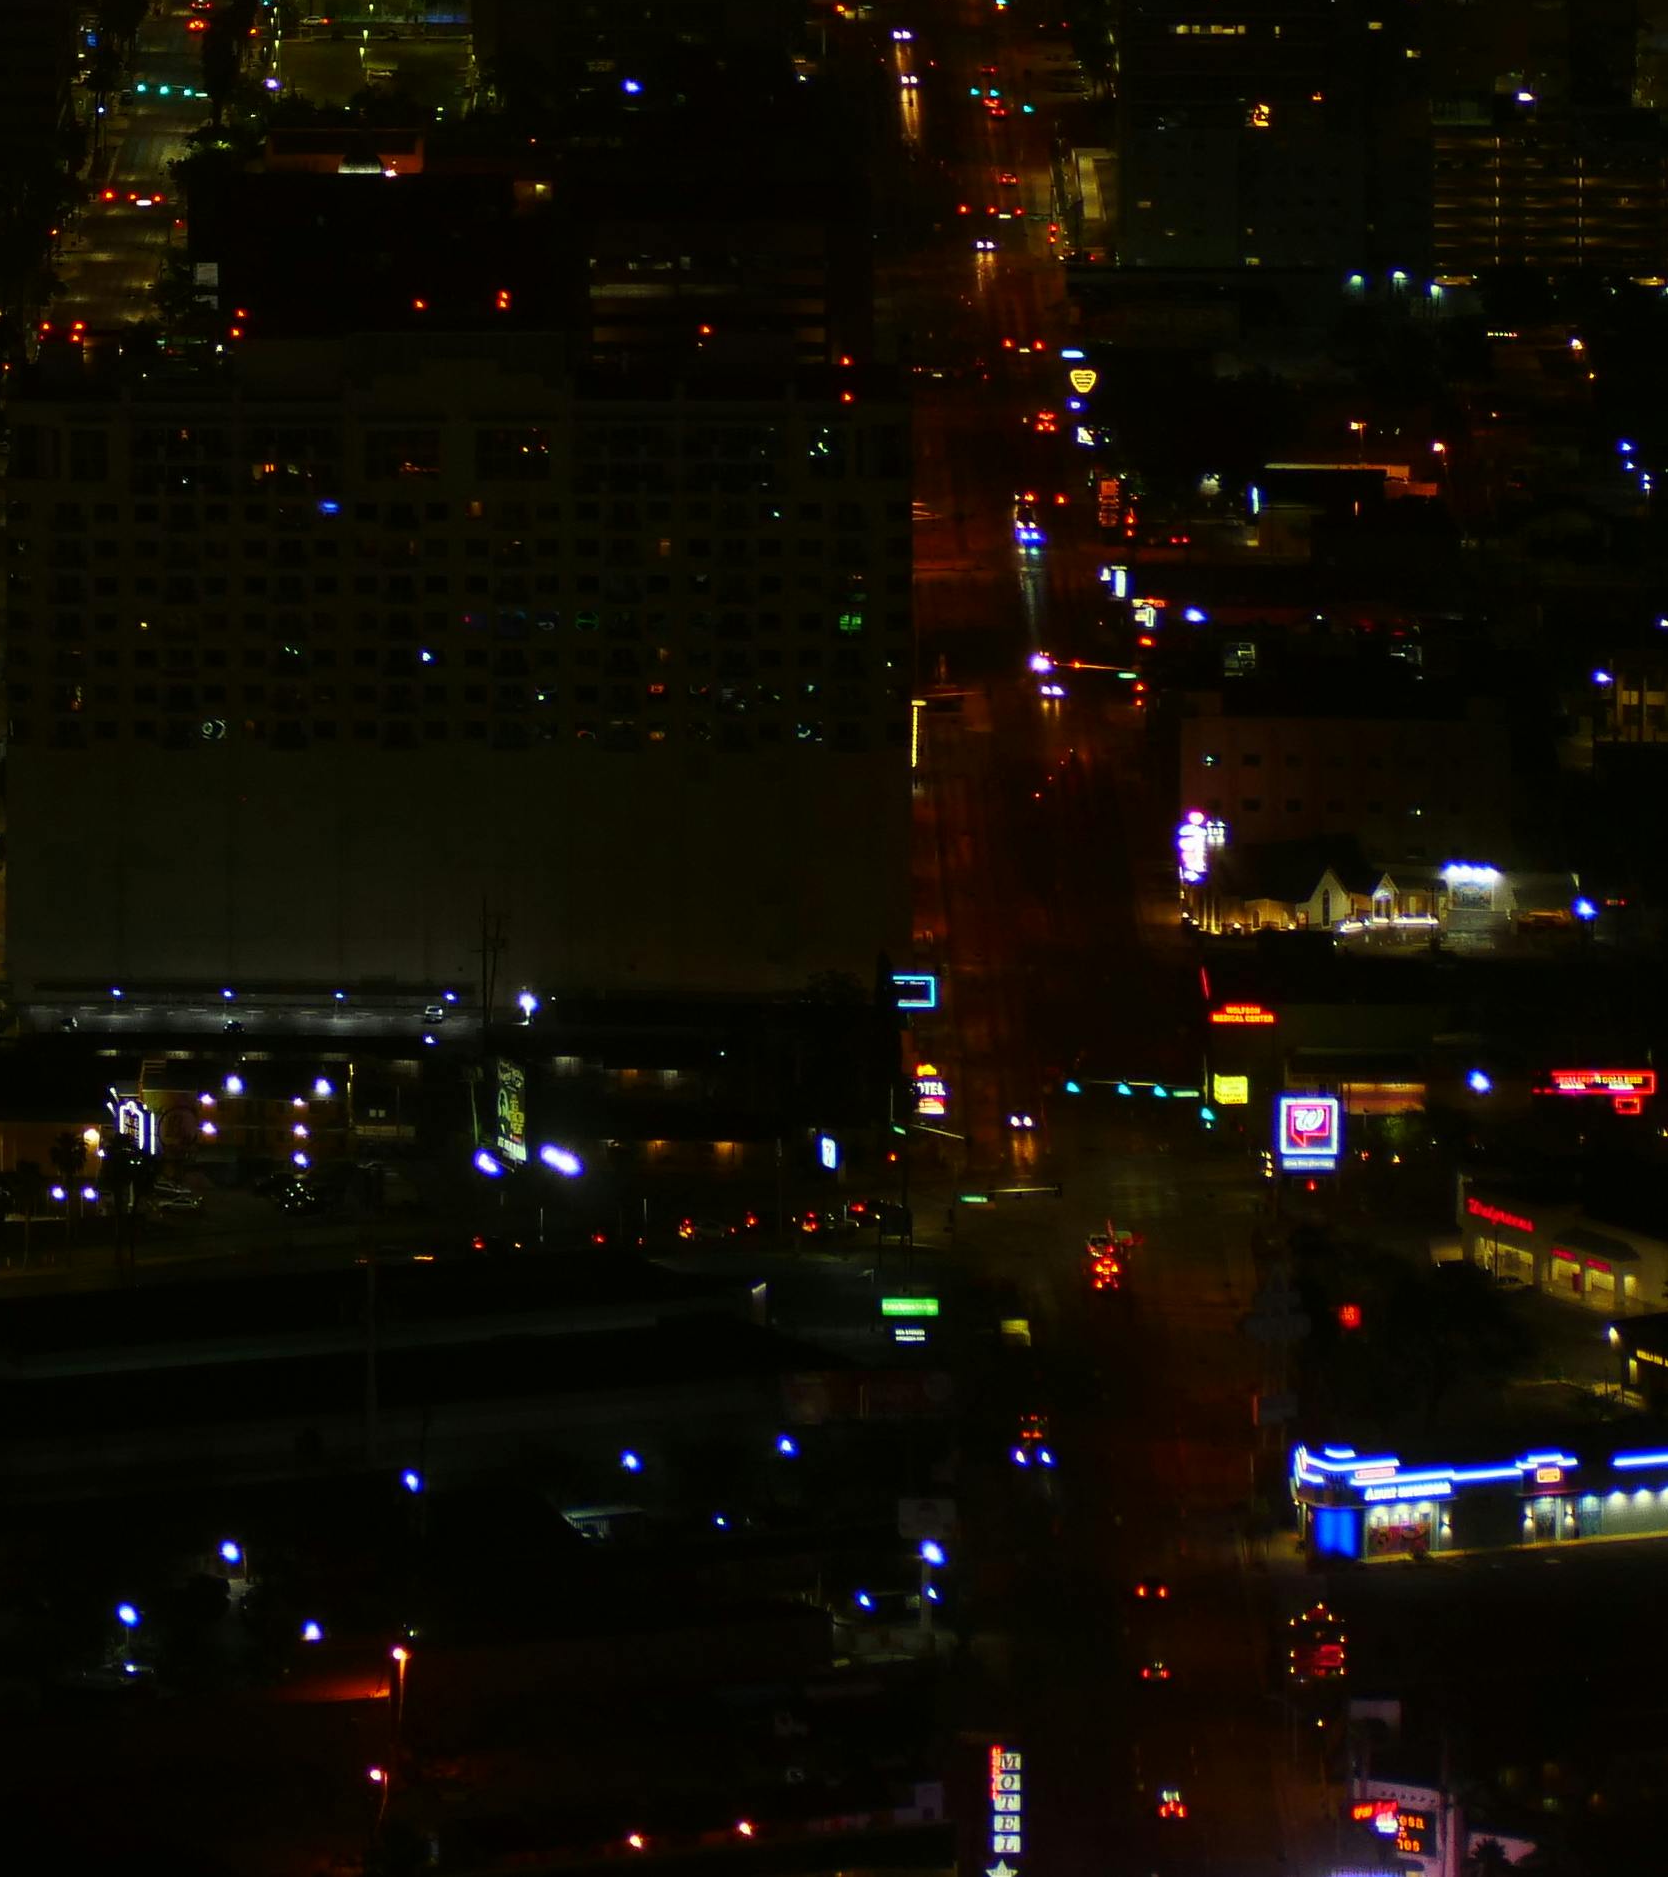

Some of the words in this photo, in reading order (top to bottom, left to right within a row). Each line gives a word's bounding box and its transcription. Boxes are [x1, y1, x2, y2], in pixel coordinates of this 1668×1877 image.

[1245, 1015, 1273, 1023] CENTER
[1467, 1197, 1535, 1233] Walgreens
[1000, 1754, 1018, 1852] MOTEL
